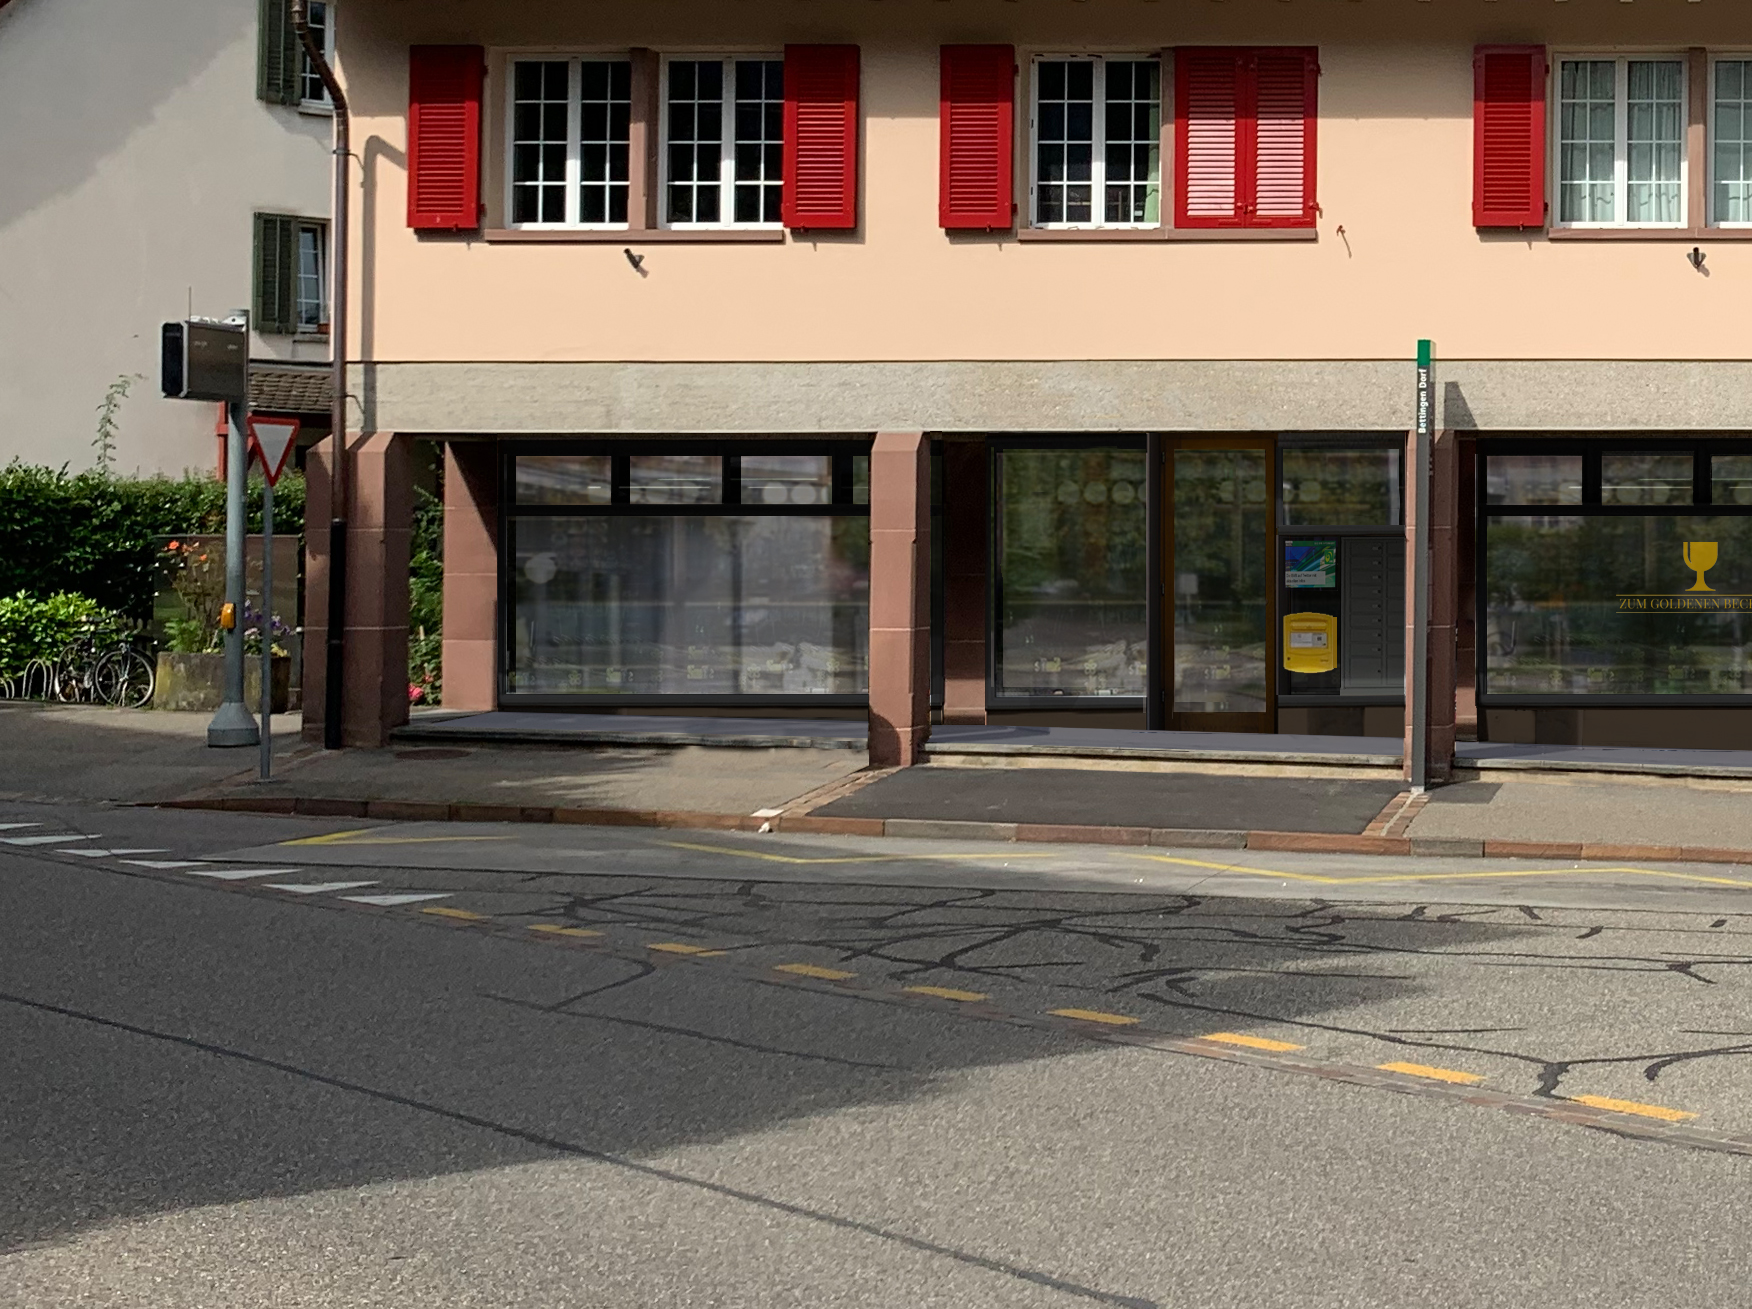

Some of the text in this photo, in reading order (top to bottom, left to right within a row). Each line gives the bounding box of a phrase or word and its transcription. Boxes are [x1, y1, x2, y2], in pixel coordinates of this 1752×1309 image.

[1418, 368, 1429, 434] Bettingen Dorf
[1619, 598, 1647, 610] ZUM
[1650, 598, 1720, 610] GOLDENEN
